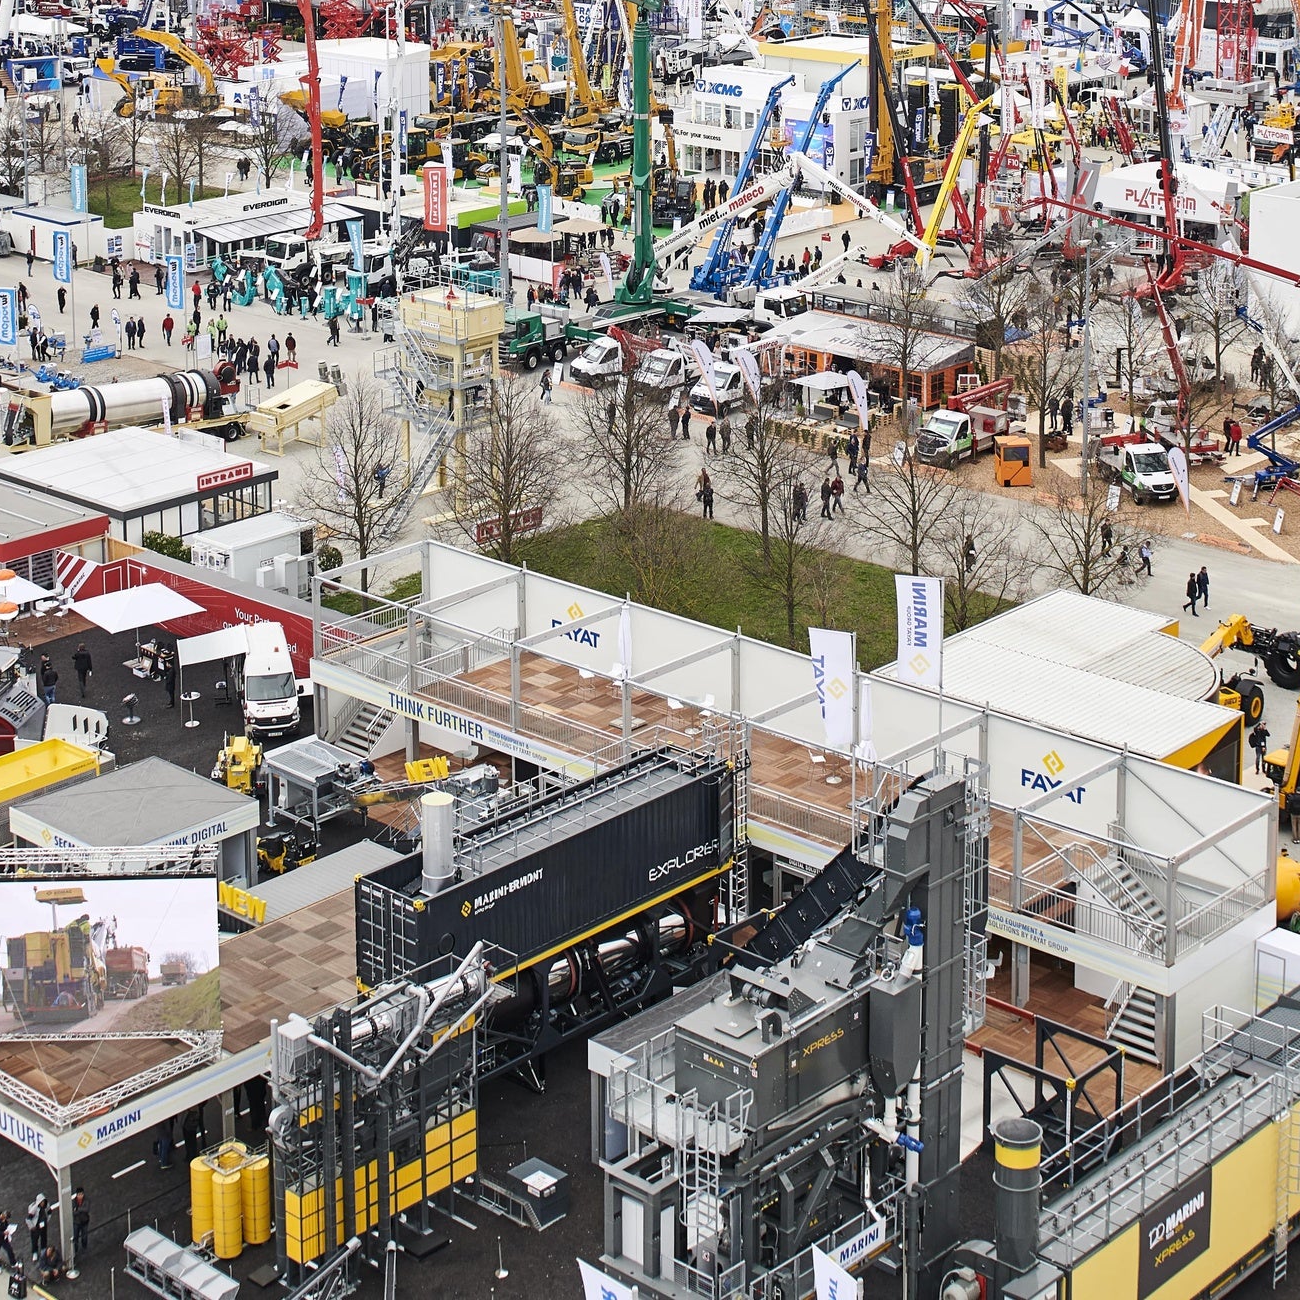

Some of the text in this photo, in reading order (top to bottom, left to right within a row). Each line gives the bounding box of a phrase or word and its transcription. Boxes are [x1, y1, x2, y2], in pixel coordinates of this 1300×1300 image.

[708, 81, 743, 97] XCMG
[1257, 128, 1290, 141] PLATFORM
[144, 205, 181, 219] EVERDIGM
[243, 197, 288, 212] EVERDIGM
[728, 185, 765, 213] mateco
[846, 192, 871, 215] mateco
[201, 466, 250, 487] INTRAME
[235, 607, 253, 622] Your
[389, 691, 484, 741] THINK FURTHER
[405, 756, 449, 784] NEW
[191, 820, 229, 843] DIGITAL
[219, 881, 267, 925] NEW
[988, 920, 1070, 954] SOLUTIONS BY FAYAT GROUP
[1004, 917, 1038, 936] EQUIPMENT
[802, 1028, 845, 1057] XPRESS
[96, 1109, 141, 1140] MARINI
[1165, 1191, 1205, 1231] MARINI
[839, 1227, 879, 1263] MARINI
[1154, 1229, 1196, 1268] XPRESS
